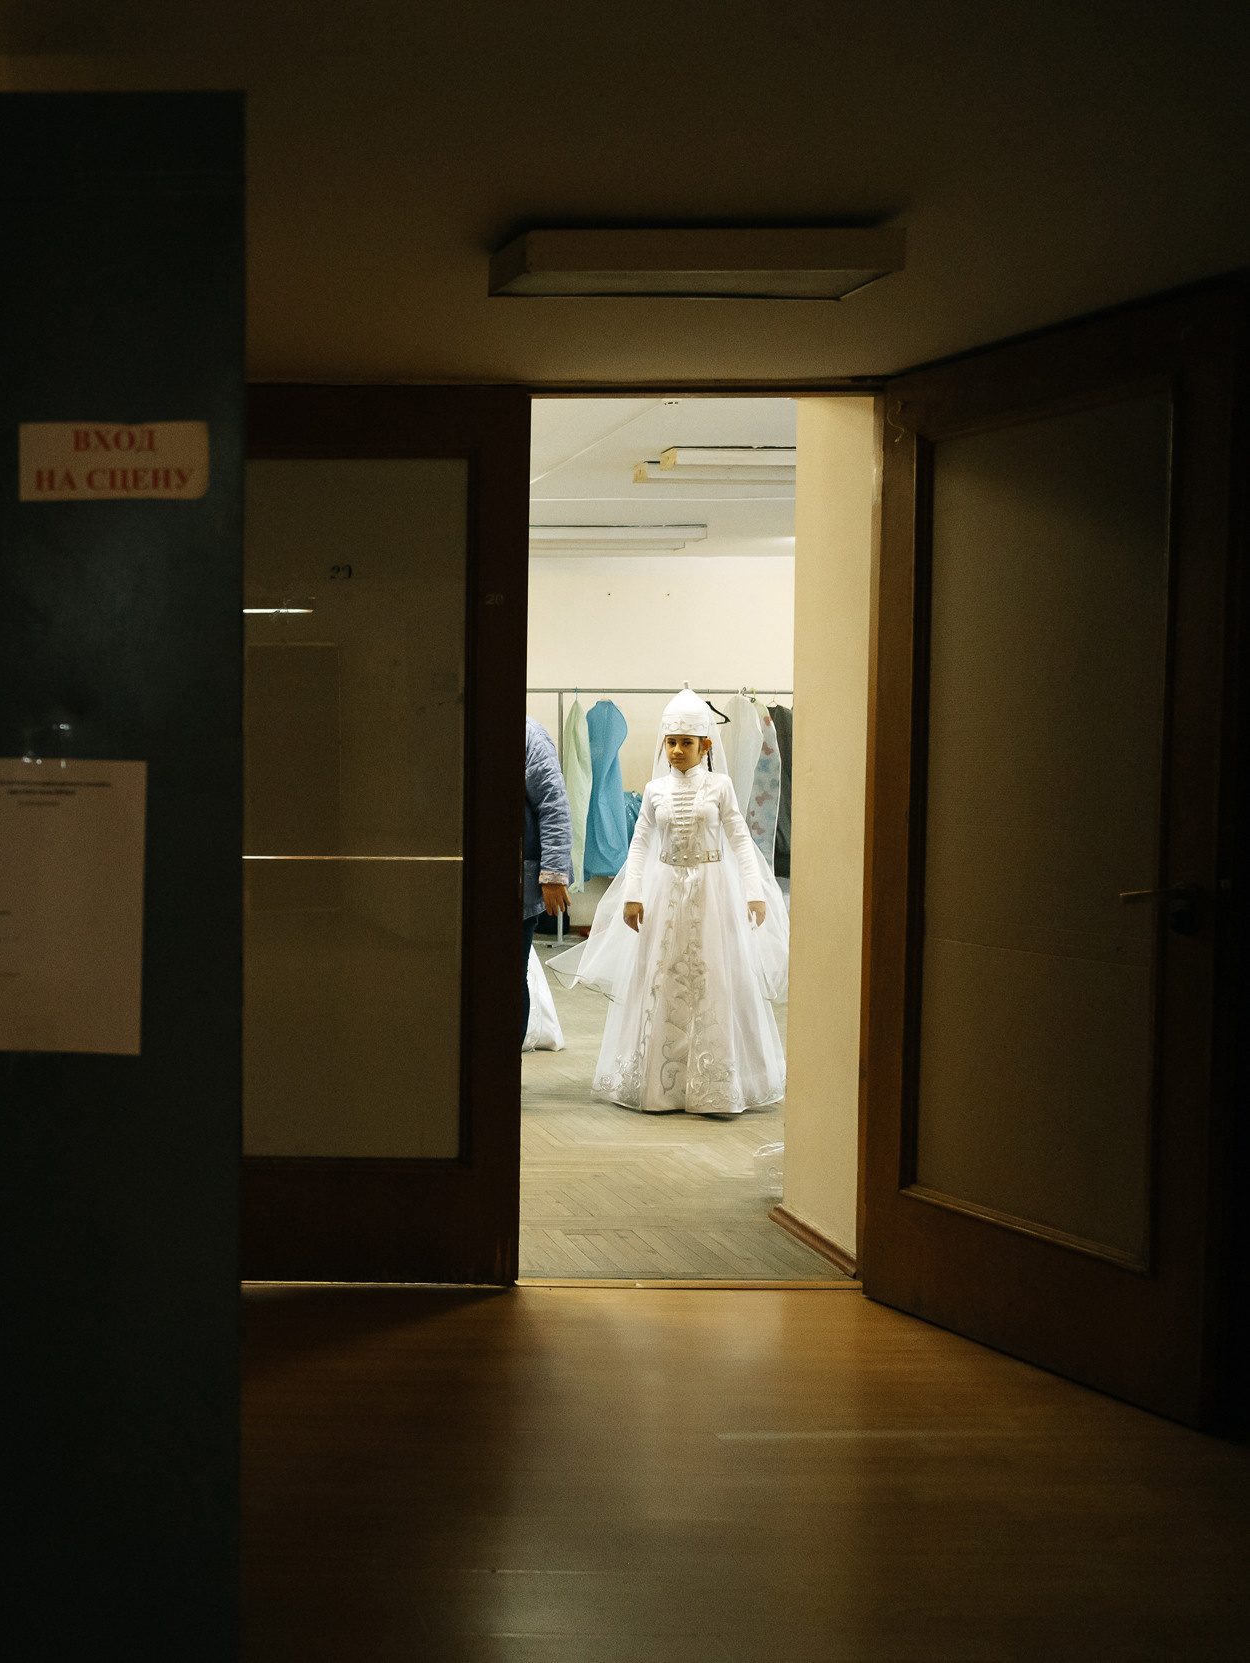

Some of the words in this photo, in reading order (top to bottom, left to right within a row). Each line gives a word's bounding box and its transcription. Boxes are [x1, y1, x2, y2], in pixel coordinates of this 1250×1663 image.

[73, 429, 156, 453] ВХОД
[35, 468, 78, 491] НА
[86, 466, 193, 492] СЦЕНУ
